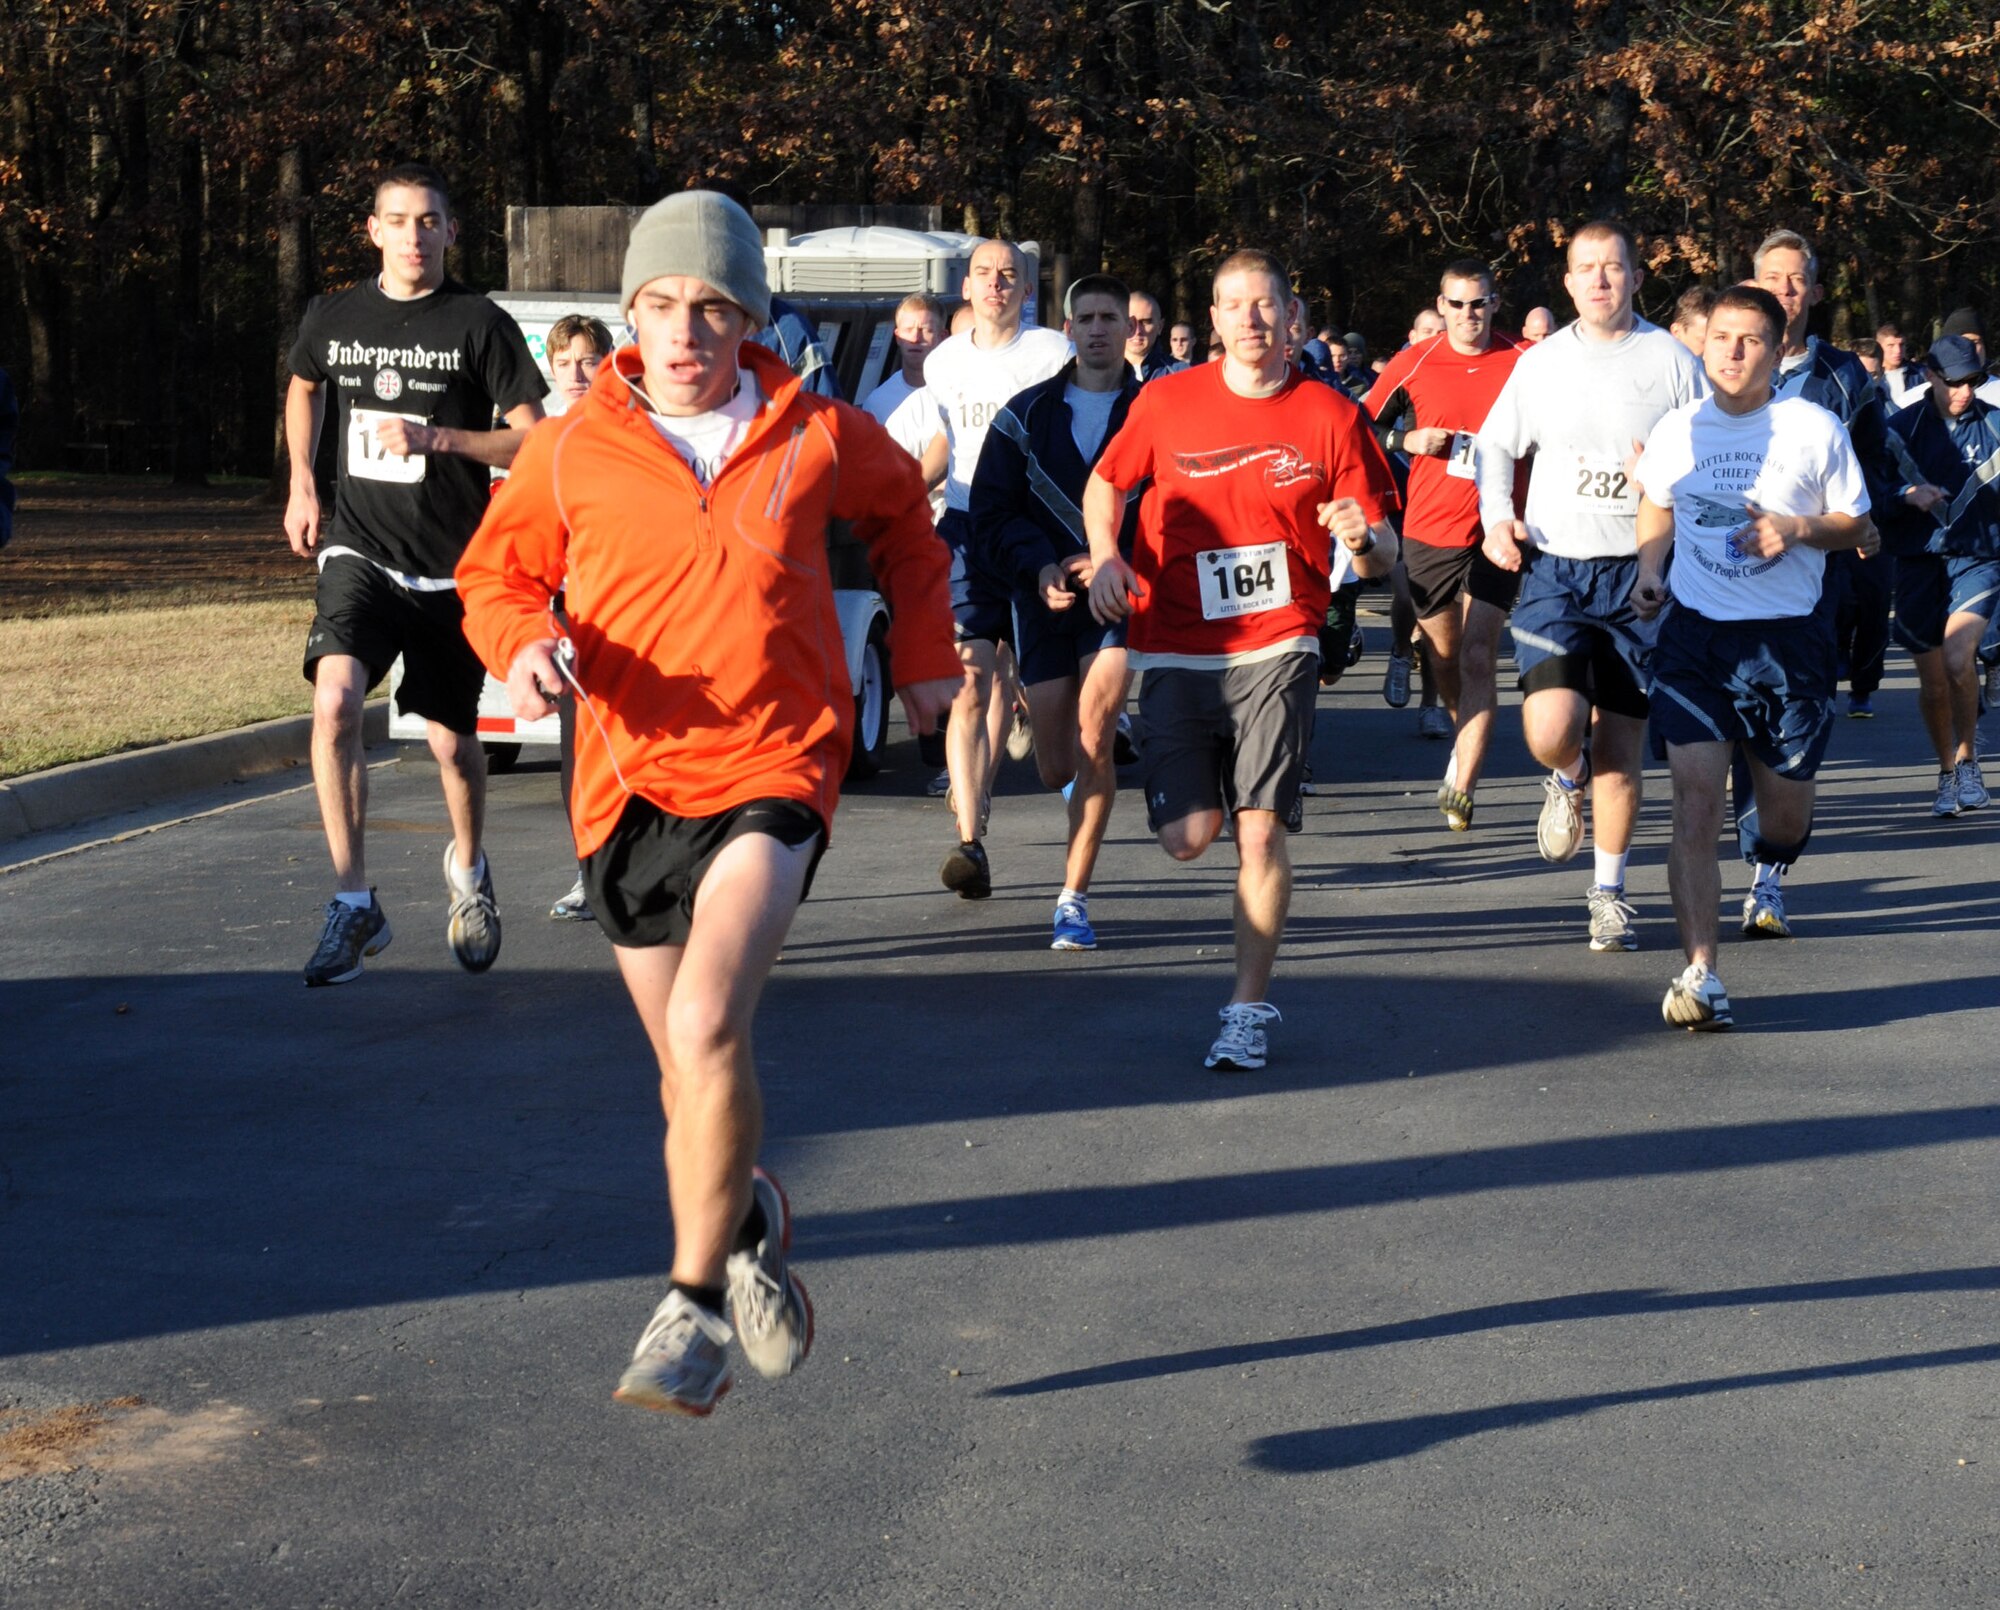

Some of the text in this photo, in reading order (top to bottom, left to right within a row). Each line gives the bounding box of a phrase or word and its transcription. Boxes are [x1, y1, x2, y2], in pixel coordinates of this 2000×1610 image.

[327, 339, 461, 371] Independent
[339, 375, 362, 387] Truck
[407, 378, 448, 393] Company
[959, 401, 999, 428] 180
[1695, 452, 1732, 472] LITTLE
[1734, 451, 1764, 464] ROCK
[1576, 469, 1628, 499] 232
[1714, 482, 1734, 491] FUN
[1213, 560, 1275, 600] 164
[1714, 562, 1741, 580] People
[1220, 604, 1240, 613] LITTLE
[1243, 601, 1259, 609] ROCK
